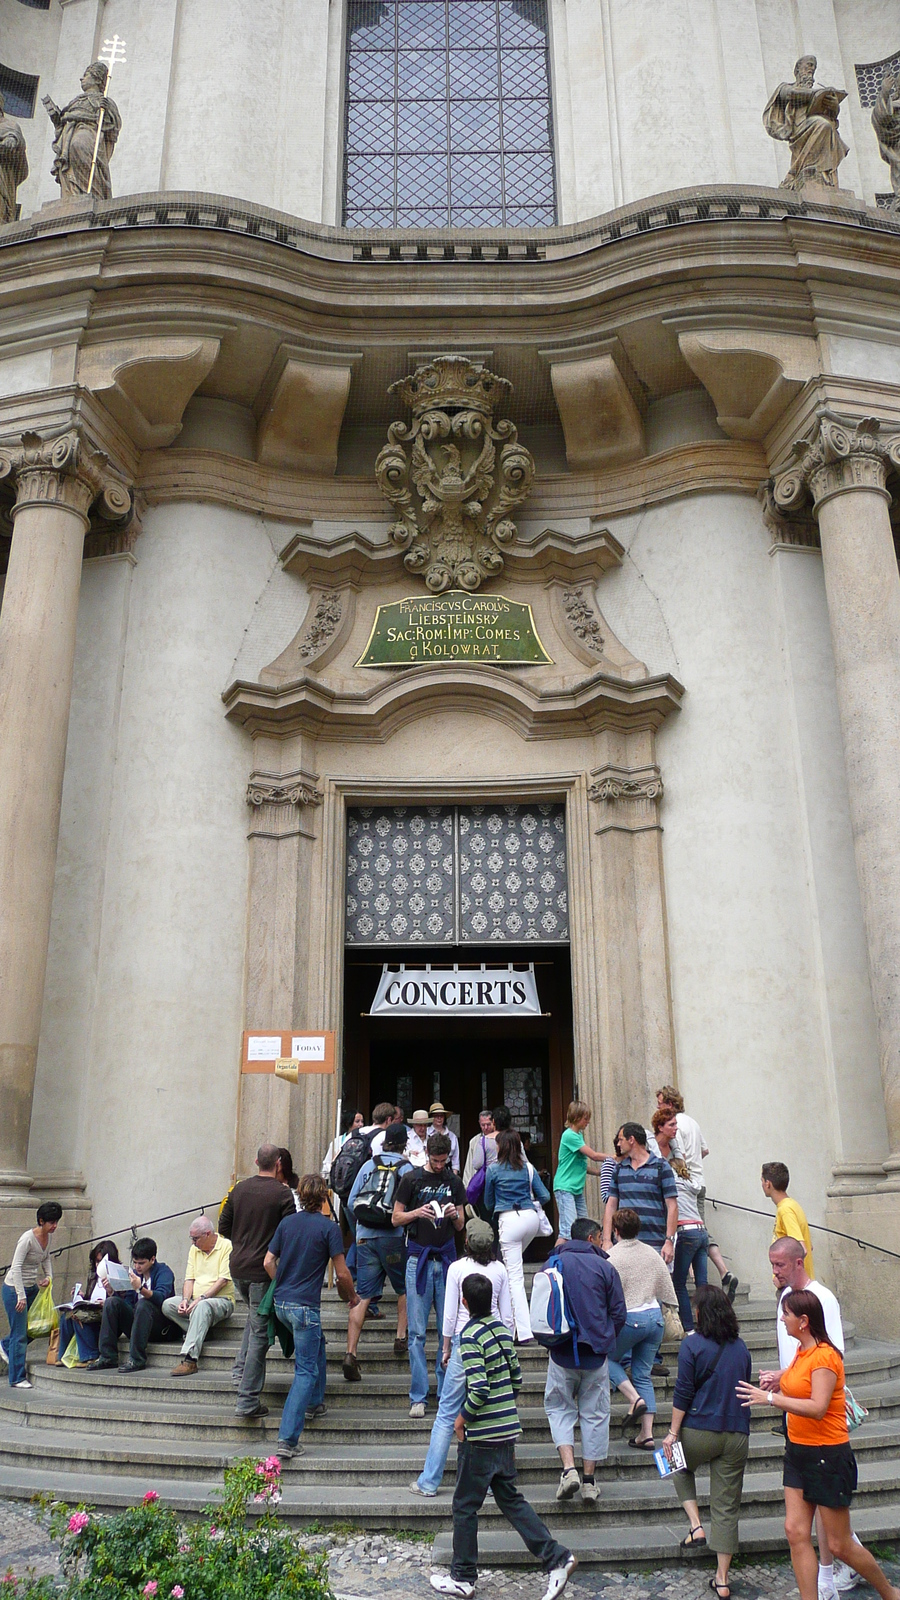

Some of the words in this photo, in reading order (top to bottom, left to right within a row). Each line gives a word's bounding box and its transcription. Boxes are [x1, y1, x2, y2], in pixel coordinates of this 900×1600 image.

[462, 598, 510, 613] CAROLVS
[422, 641, 500, 656] KOLOWRAT
[385, 980, 527, 1006] CONCERTS
[295, 1044, 322, 1052] TODAY
